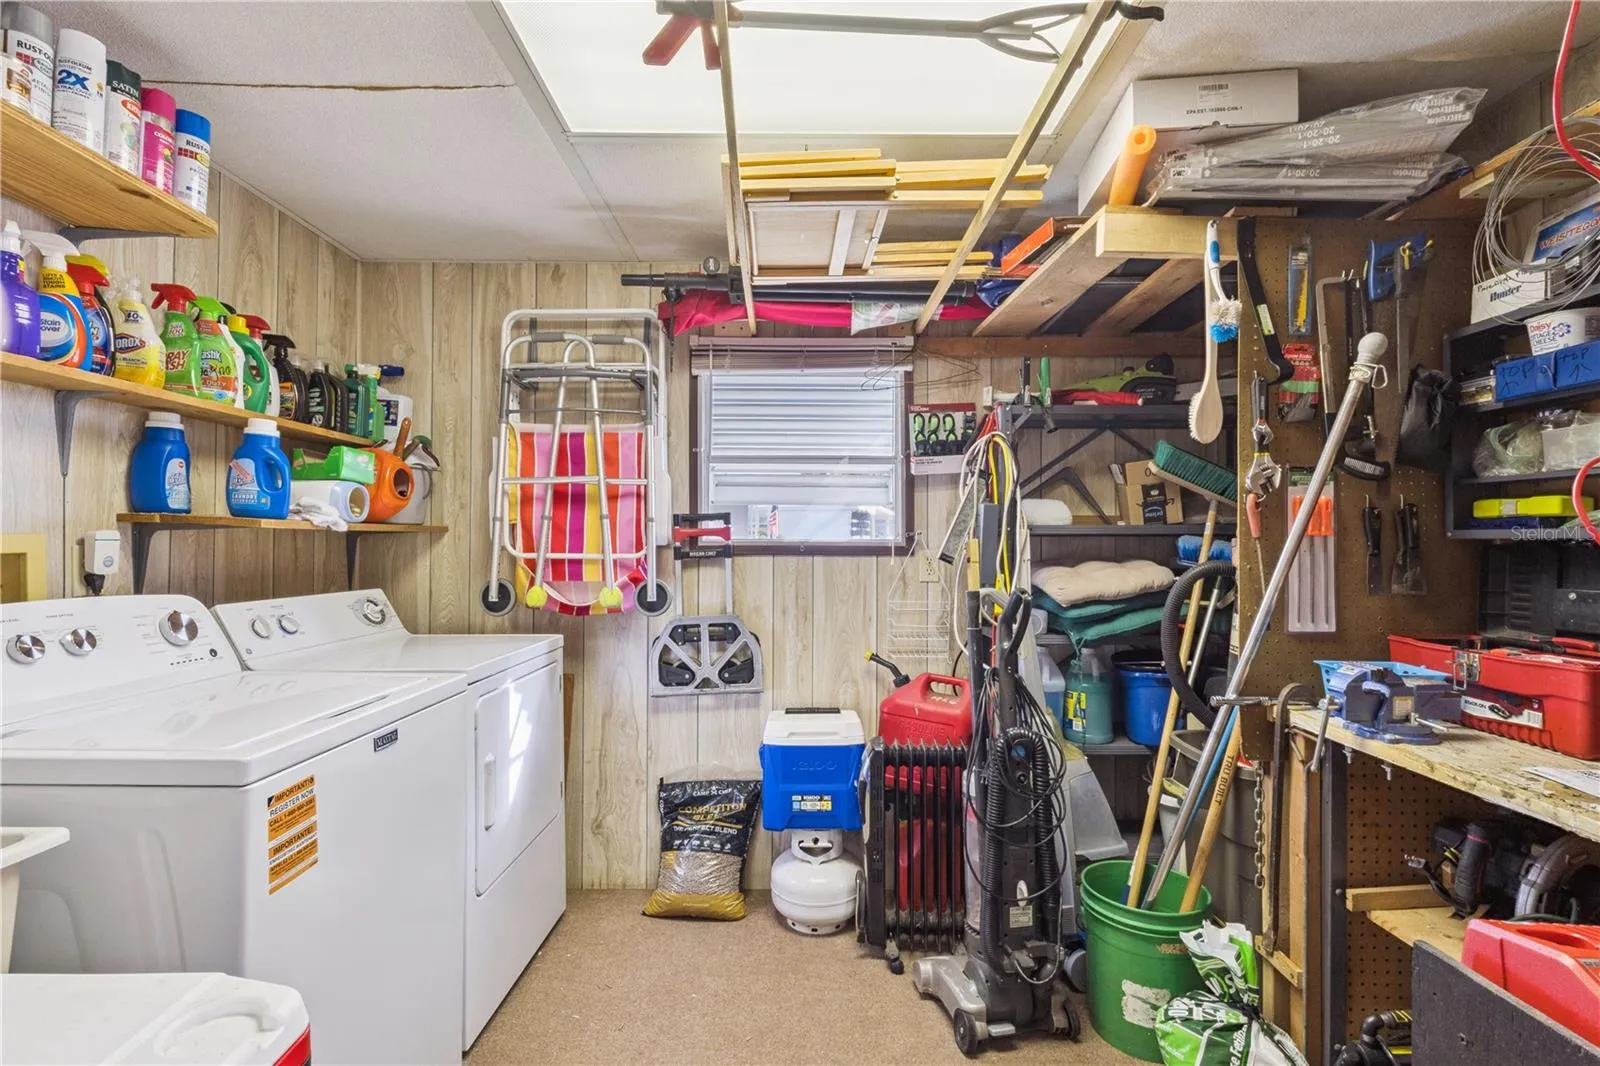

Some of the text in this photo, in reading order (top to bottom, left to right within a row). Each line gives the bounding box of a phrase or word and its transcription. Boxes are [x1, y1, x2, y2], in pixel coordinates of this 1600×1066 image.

[57, 69, 90, 92] 2X
[112, 79, 139, 97] SATIN
[1489, 284, 1522, 302] Hunter
[1530, 321, 1552, 334] Daisy
[116, 337, 140, 349] OROX
[1214, 754, 1235, 806] TRU BUILT
[270, 795, 300, 818] REGISTER
[300, 788, 315, 801] NOW
[269, 816, 283, 828] CALL
[714, 826, 738, 836] BLEND
